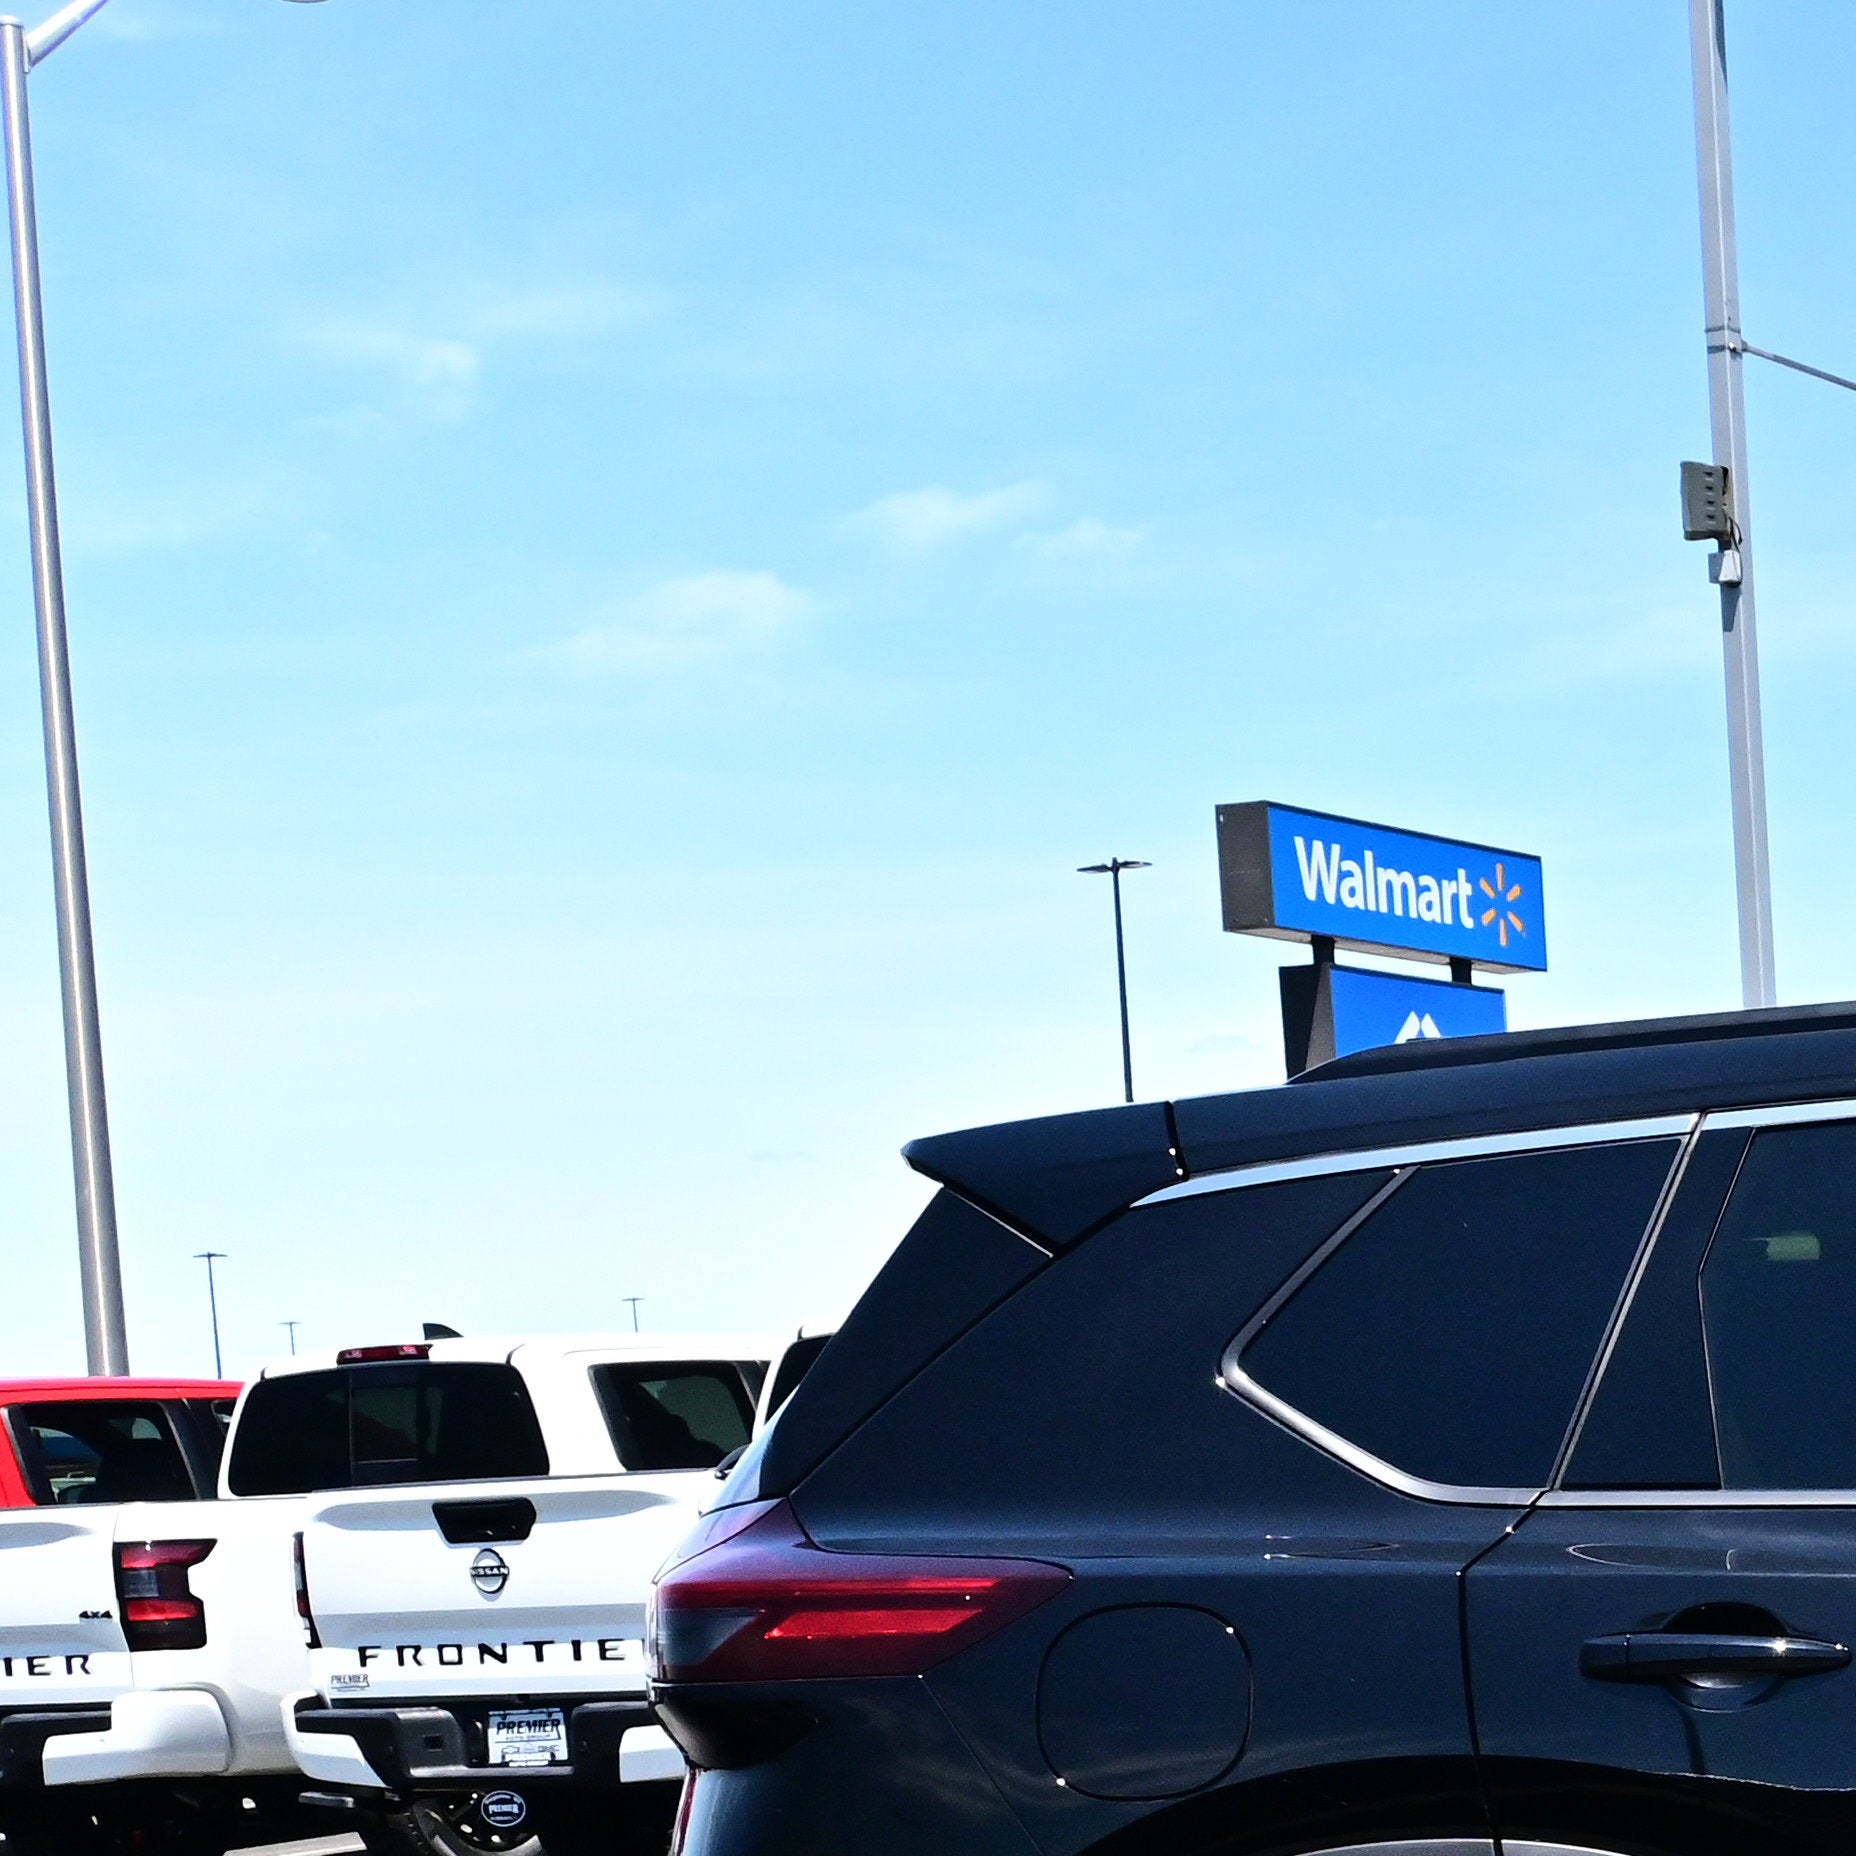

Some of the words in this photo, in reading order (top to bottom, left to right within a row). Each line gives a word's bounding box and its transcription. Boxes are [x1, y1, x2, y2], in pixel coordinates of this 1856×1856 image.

[1294, 835, 1475, 930] Walmart
[358, 1637, 645, 1668] FRONTIE
[496, 1718, 562, 1739] PREMIER
